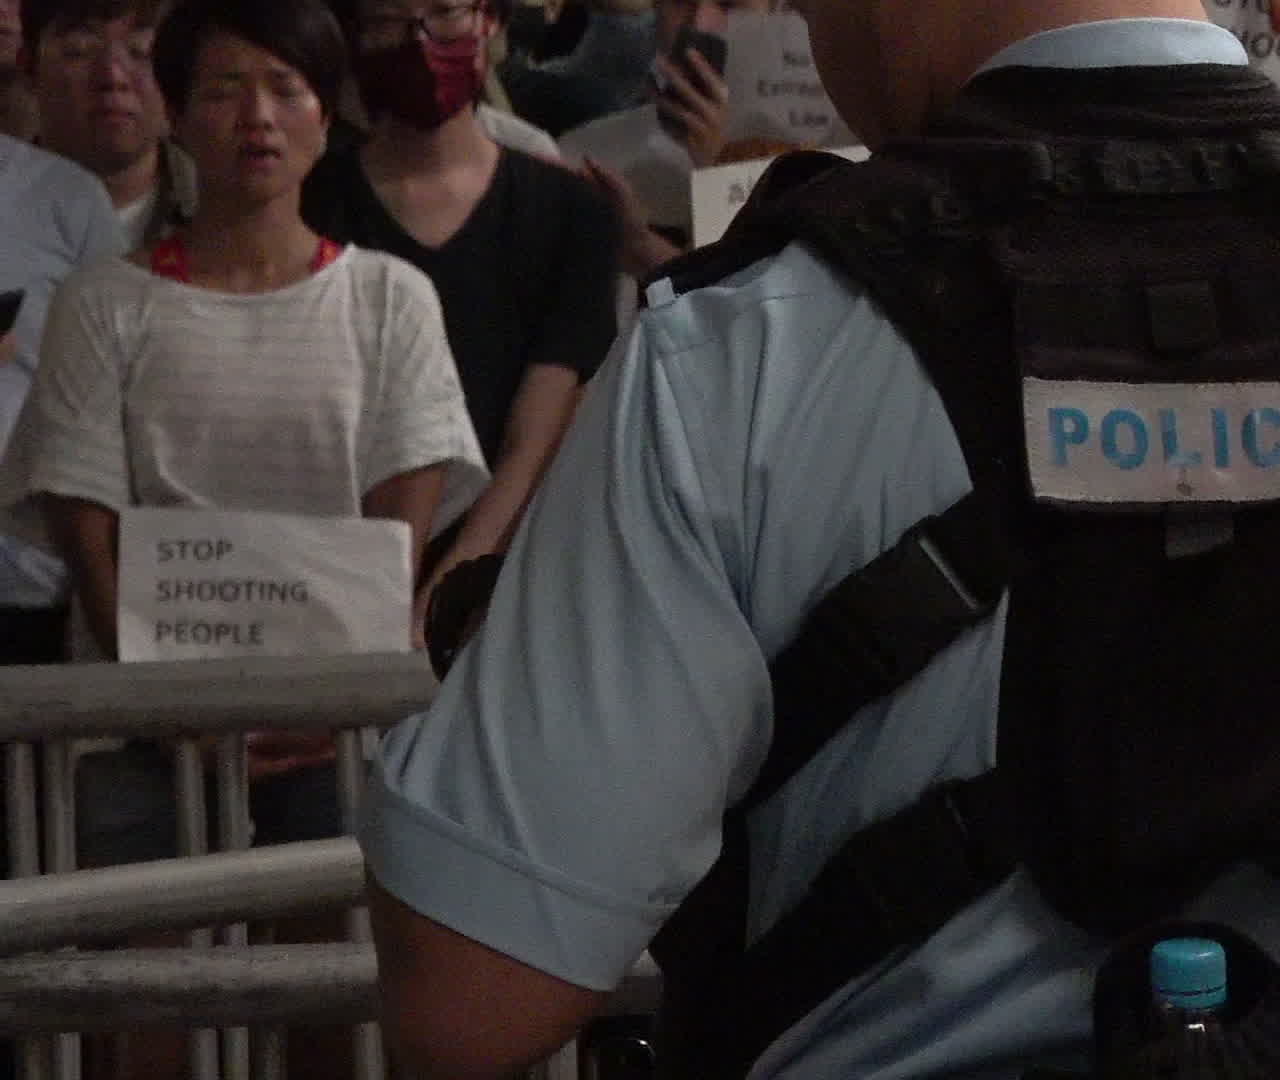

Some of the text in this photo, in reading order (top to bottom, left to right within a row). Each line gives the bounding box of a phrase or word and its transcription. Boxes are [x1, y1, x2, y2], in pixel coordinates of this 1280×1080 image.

[156, 538, 233, 562] STOP
[155, 576, 309, 604] SHOOTING
[154, 619, 264, 646] PEOPLE
